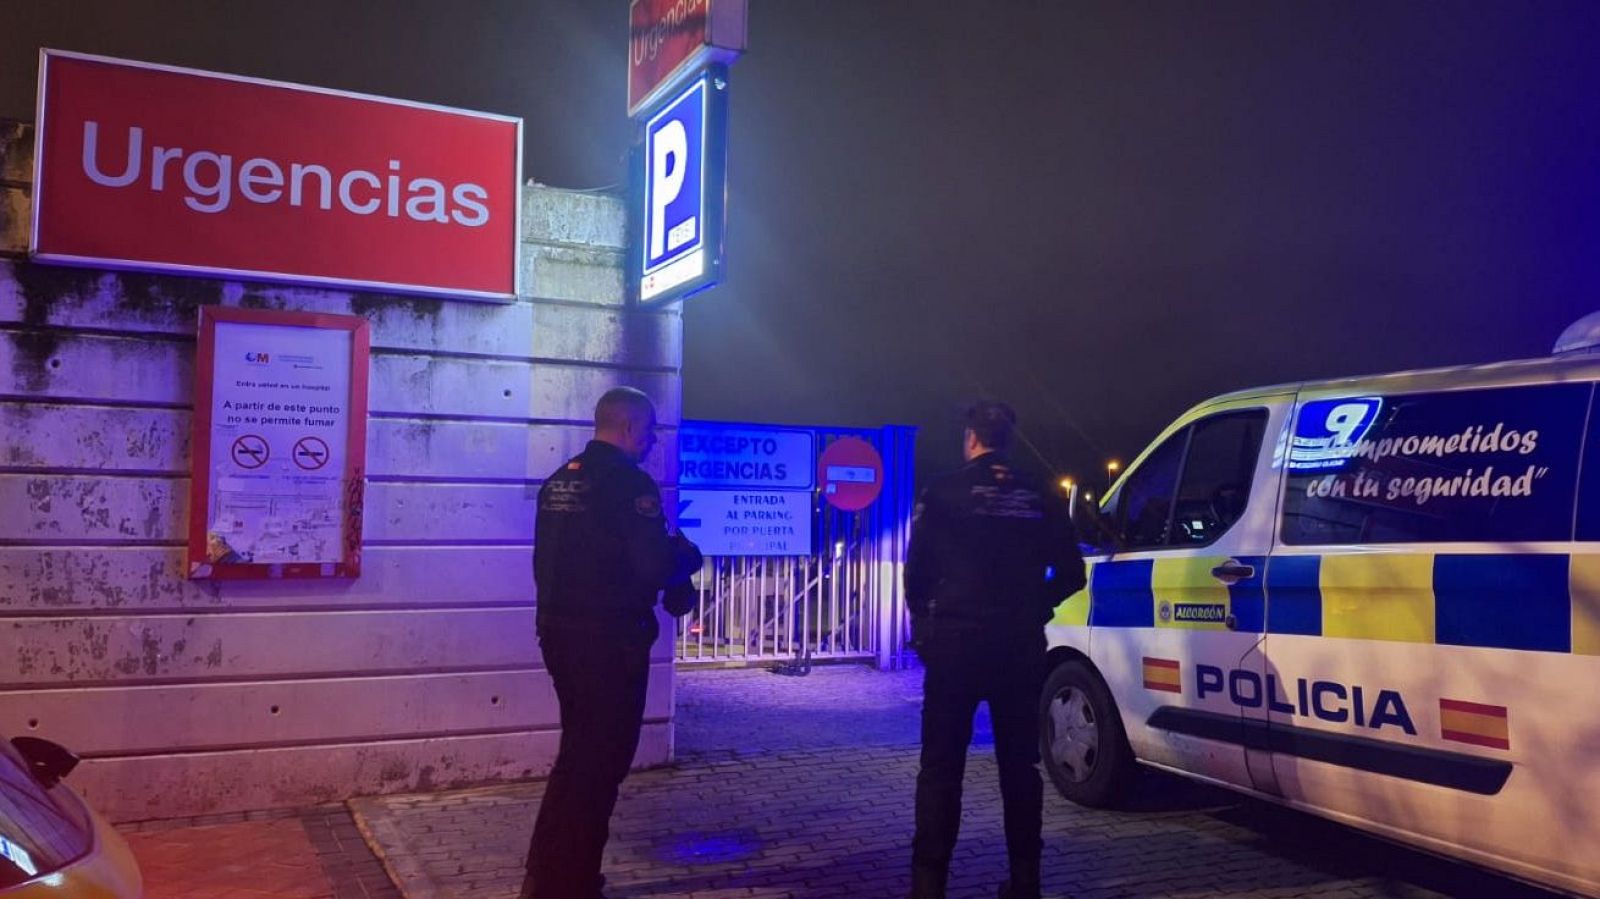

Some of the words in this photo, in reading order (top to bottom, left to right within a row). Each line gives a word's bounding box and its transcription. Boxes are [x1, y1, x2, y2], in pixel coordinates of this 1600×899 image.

[634, 0, 703, 66] Urgencia
[83, 121, 490, 226] Urgencias
[650, 119, 687, 260] P
[223, 400, 232, 409] A
[235, 402, 265, 411] partir
[267, 403, 281, 411] de
[284, 404, 306, 412] este
[309, 405, 340, 414] punto
[227, 415, 242, 423] no
[261, 416, 301, 426] permite
[305, 417, 335, 427] fumar
[683, 434, 777, 455] EXCEPTO
[1307, 475, 1345, 498] con
[1352, 472, 1379, 497] tu
[734, 495, 786, 505] ENTRADA
[726, 510, 739, 520] AL
[744, 510, 793, 520] PARKING
[724, 526, 748, 535] POR
[752, 526, 794, 536] PUERTA
[1196, 664, 1417, 736] POLICIA
